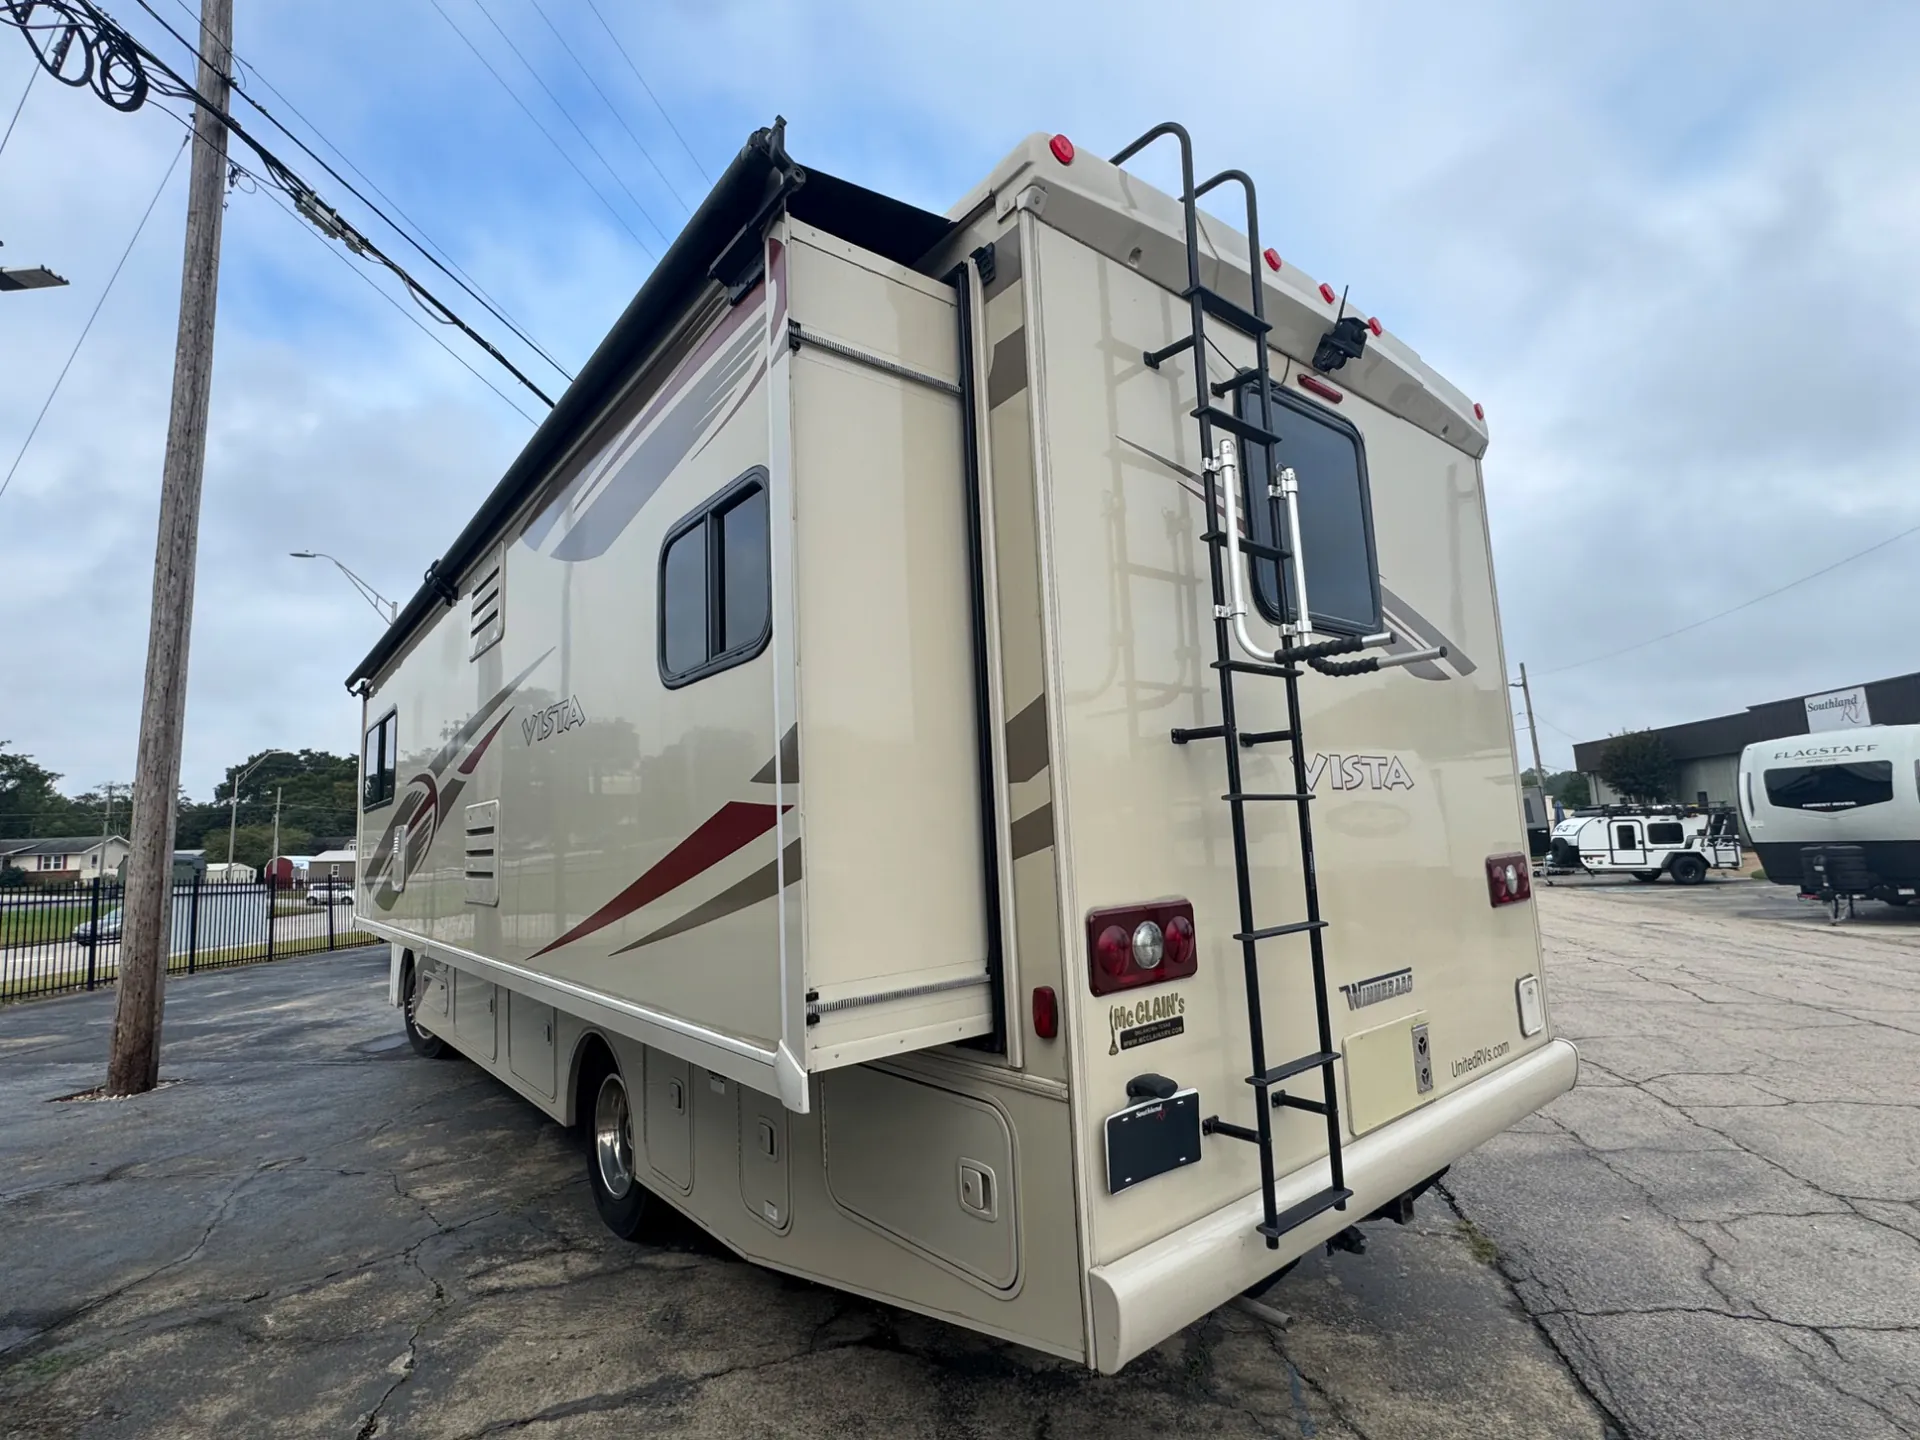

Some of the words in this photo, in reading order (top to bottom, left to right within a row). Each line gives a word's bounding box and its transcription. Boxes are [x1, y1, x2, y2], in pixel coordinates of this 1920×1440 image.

[1807, 694, 1857, 712] Southland
[1841, 700, 1866, 724] RV
[521, 694, 586, 747] VISTA
[1774, 744, 1879, 760] FLAGSTAFF
[1289, 753, 1414, 792] VISTA
[1451, 1041, 1510, 1078] UnitedRVs.com
